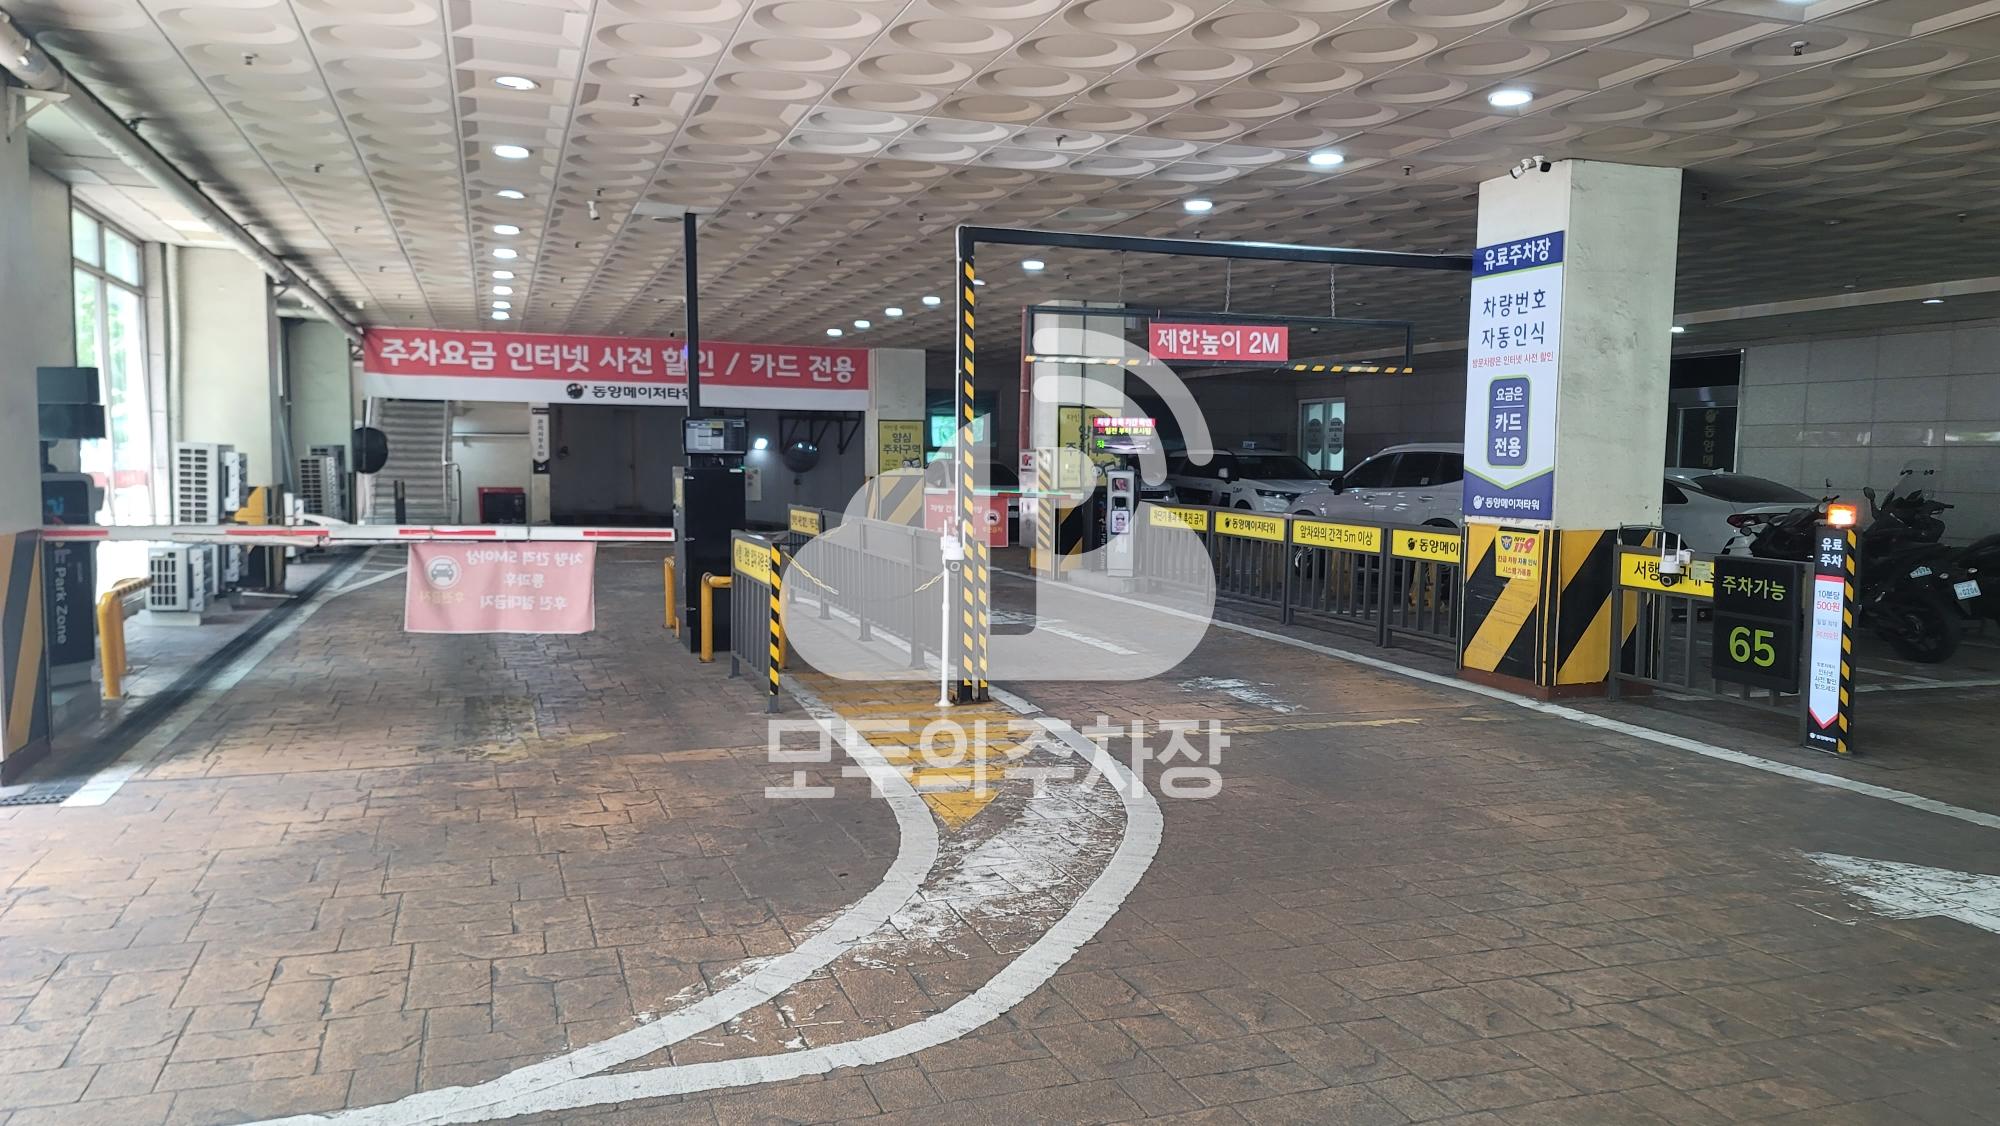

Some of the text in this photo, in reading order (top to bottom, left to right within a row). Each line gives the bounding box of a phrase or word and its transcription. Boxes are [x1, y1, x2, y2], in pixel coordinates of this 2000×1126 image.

[1484, 237, 1551, 271] 유료주차장
[1483, 288, 1546, 318] 차량번호
[1157, 328, 1279, 355] 제한높이 2M
[1482, 321, 1545, 349] 자동인식
[380, 338, 497, 371] 주차요금
[506, 342, 590, 373] 인터넷
[599, 346, 653, 375] 사전
[750, 354, 800, 378] 카드
[808, 355, 856, 383] 전용
[1472, 351, 1554, 368] 방문차량은 인터넷 사전 할인
[1495, 386, 1523, 402] 요금은
[1495, 412, 1522, 432] 카드
[892, 433, 912, 443] 양심
[1494, 437, 1521, 457] 전용
[883, 445, 921, 455] 주차구역
[1485, 497, 1540, 511] 동양메이저타워
[1300, 525, 1374, 546] 앞차와의 간격 5m 이상
[1821, 537, 1843, 552] 유료
[1419, 538, 1459, 556] 동양메이
[1634, 560, 1660, 581] 서행
[1820, 553, 1843, 568] 주차
[55, 566, 67, 602] Park
[1722, 575, 1787, 601] 주차가능
[1817, 590, 1840, 601] 10분당
[1816, 601, 1840, 613] 500원
[56, 605, 68, 645] Zone
[1729, 626, 1776, 668] 65
